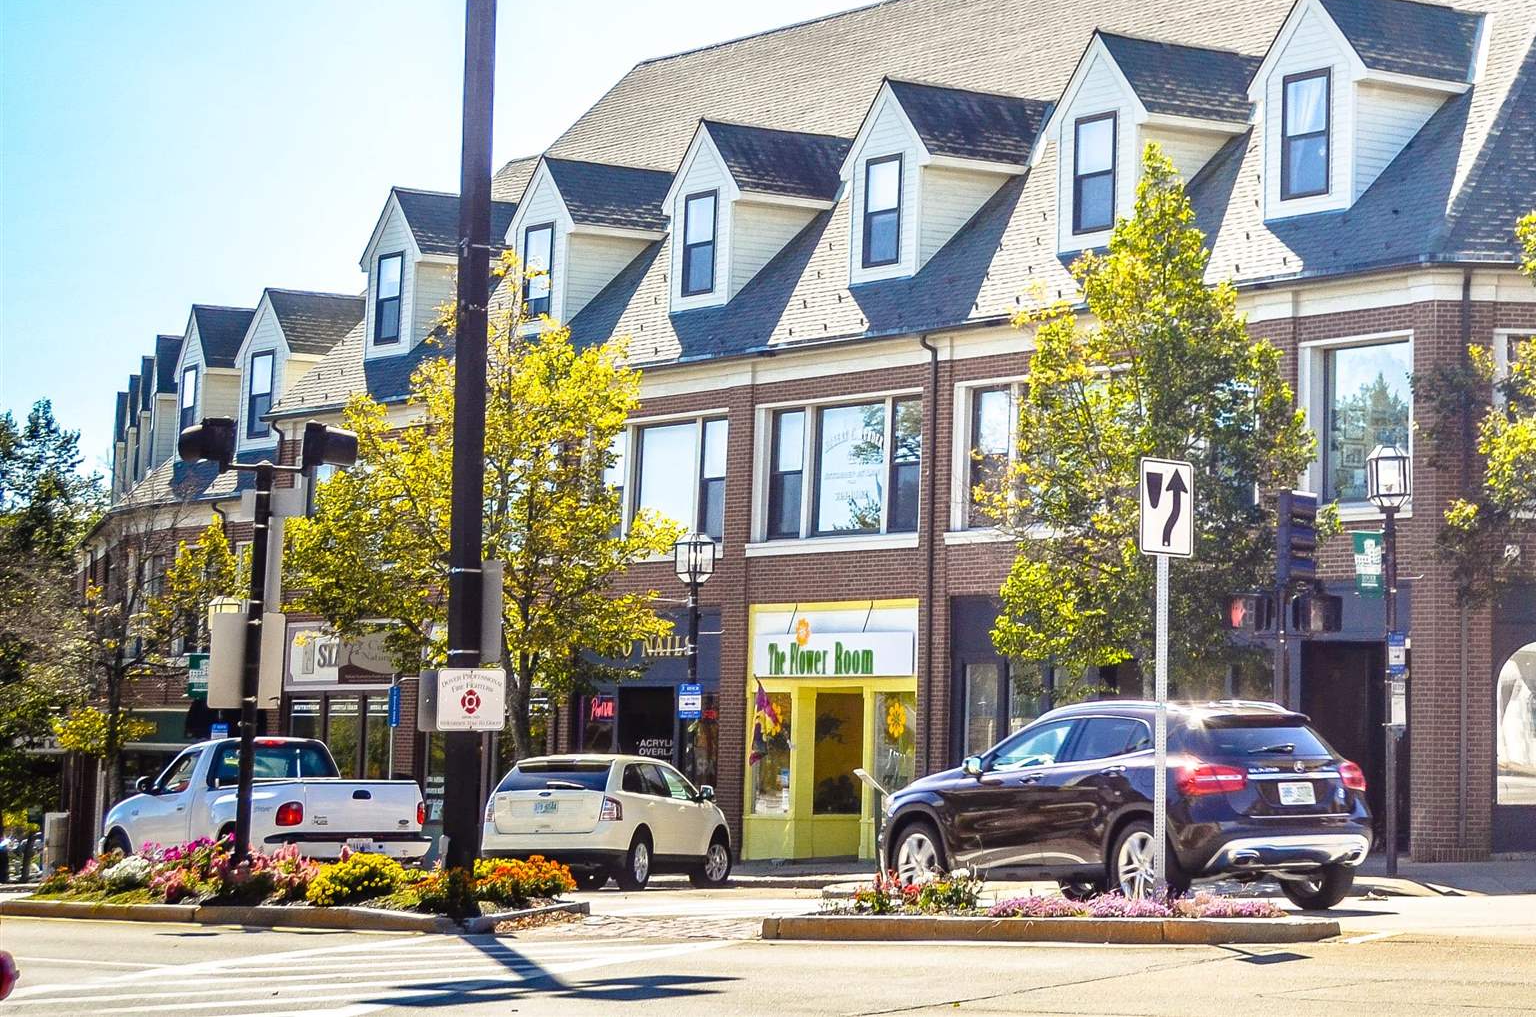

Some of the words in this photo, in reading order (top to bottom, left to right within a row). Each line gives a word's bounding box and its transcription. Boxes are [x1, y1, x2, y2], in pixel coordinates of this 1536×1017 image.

[768, 642, 786, 675] The
[790, 641, 829, 675] Flower
[834, 641, 874, 675] Room
